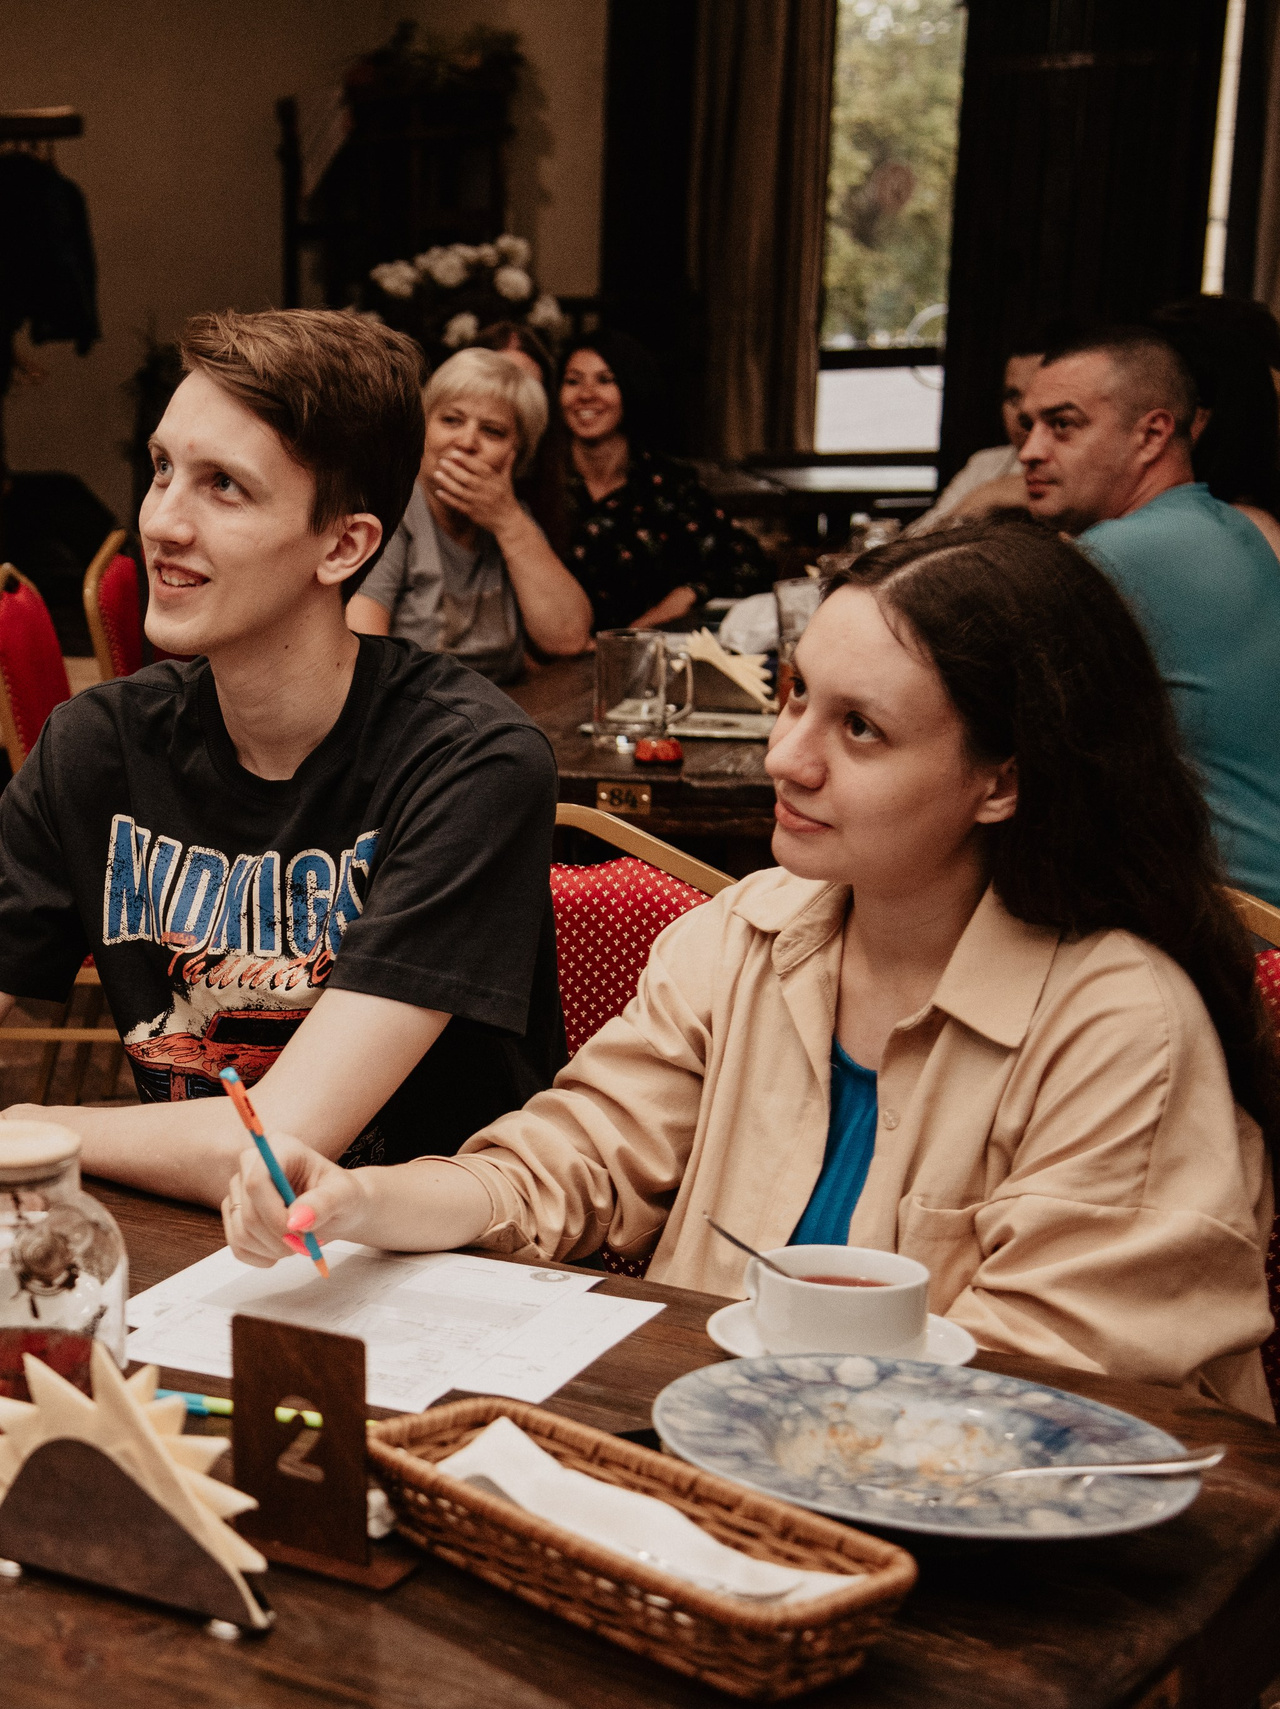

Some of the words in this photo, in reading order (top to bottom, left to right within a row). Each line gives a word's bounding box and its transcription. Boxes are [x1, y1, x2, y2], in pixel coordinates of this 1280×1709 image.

[609, 787, 638, 808] 84
[102, 813, 381, 961] MIDNIG
[160, 930, 334, 990] Thunde
[274, 1394, 324, 1483] 2
